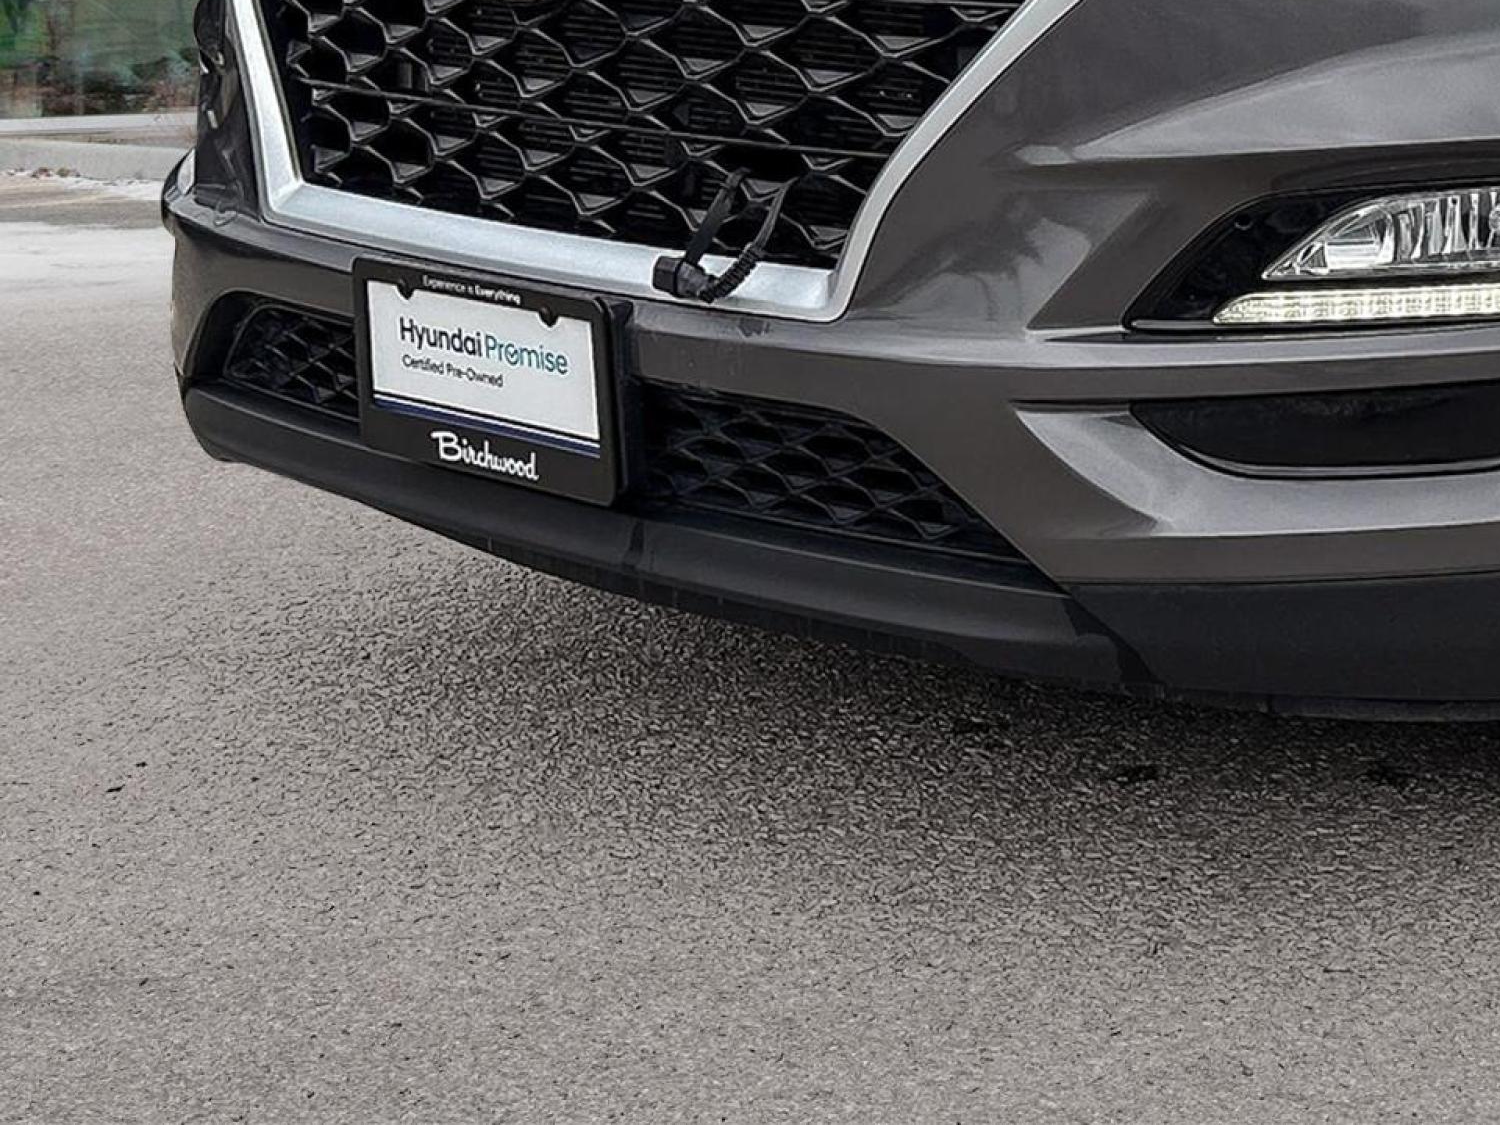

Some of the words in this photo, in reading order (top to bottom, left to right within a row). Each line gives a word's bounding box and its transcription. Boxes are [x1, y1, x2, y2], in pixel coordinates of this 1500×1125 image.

[399, 316, 483, 358] Hyundai
[485, 334, 569, 376] Promise
[401, 354, 444, 375] Certified
[445, 362, 503, 388] Pre-Owned
[430, 430, 540, 481] Birchwood
